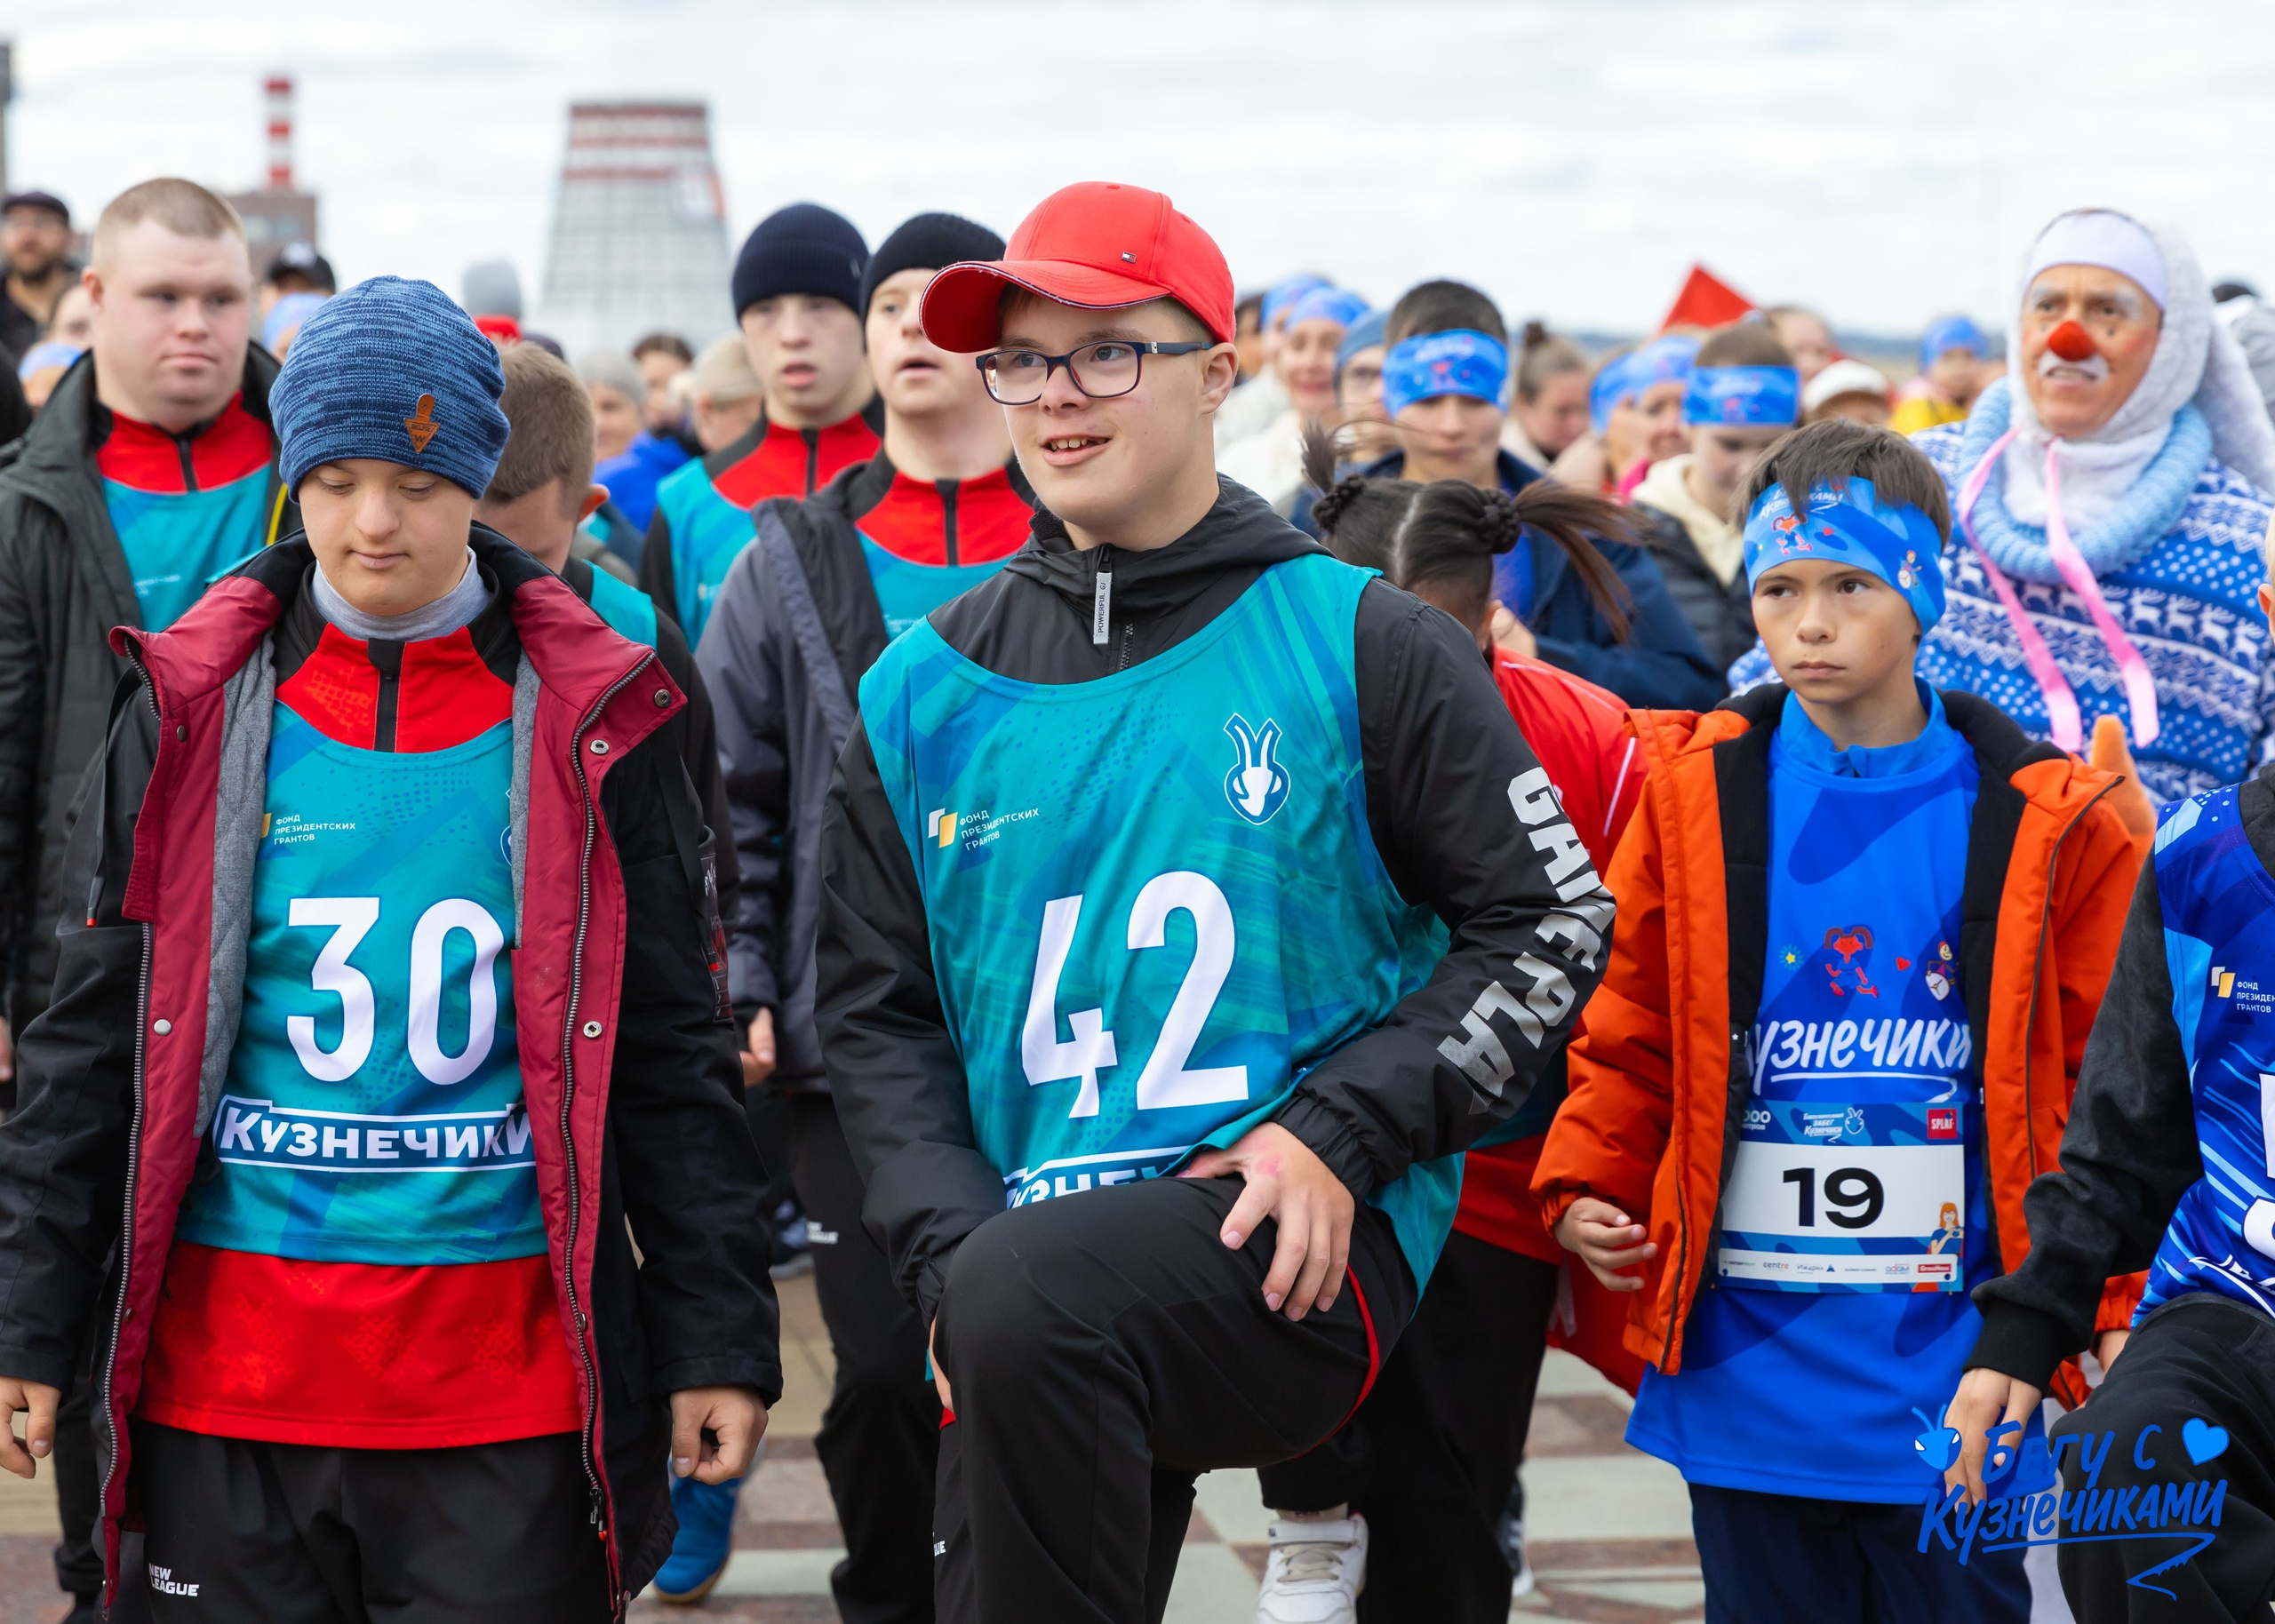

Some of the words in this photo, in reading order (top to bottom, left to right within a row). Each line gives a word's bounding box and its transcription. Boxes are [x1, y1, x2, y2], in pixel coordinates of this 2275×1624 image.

[275, 814, 301, 825] ФОНД
[959, 809, 990, 826] ФОНД
[961, 808, 1040, 840] ПРЕЗИДЕНТСКИХ
[275, 823, 356, 835] ПРЕЗИДЕНТСКИХ
[274, 833, 315, 845] ГРАНТОВ
[965, 831, 1001, 851] ГРАНТОВ
[287, 897, 504, 1085] 30
[1022, 871, 1249, 1118] 42
[2237, 981, 2259, 991] ФОНД
[2236, 1003, 2271, 1014] ГРАНТОВ
[1783, 1167, 1884, 1229] 19
[148, 1563, 172, 1580] NEW
[149, 1572, 200, 1596] LEAGUE
